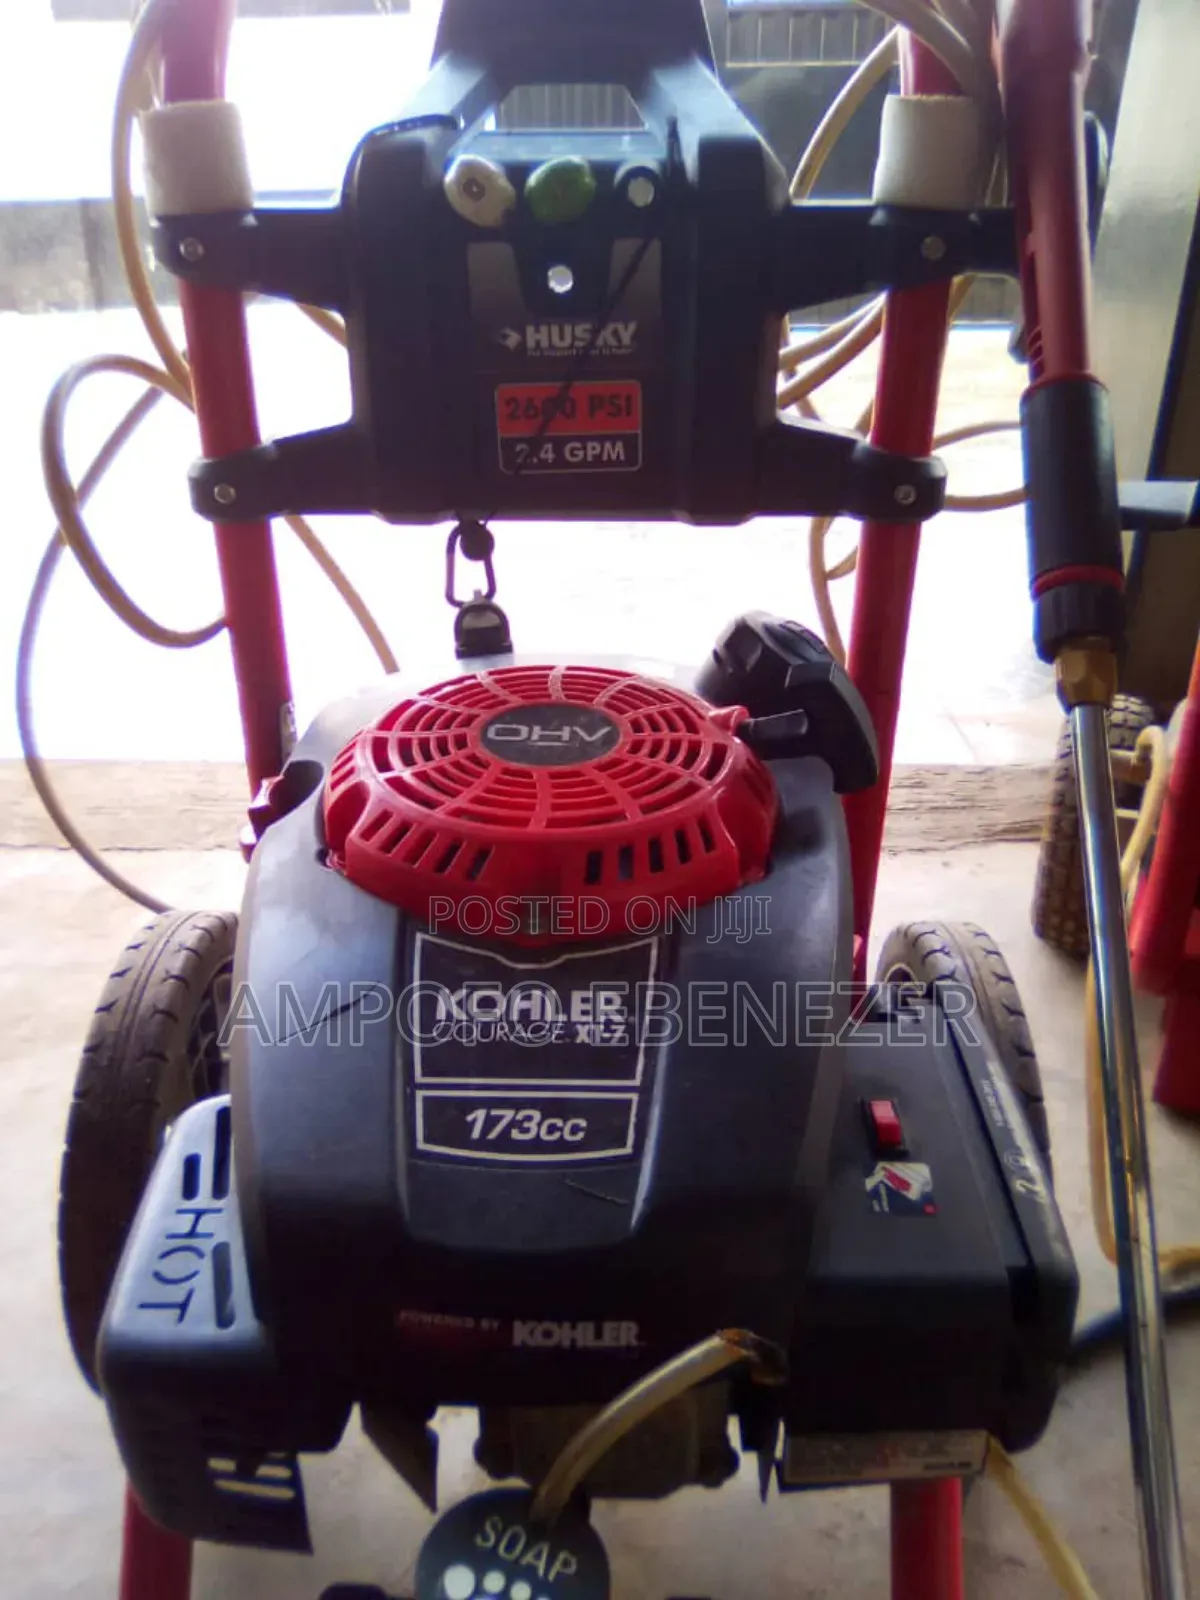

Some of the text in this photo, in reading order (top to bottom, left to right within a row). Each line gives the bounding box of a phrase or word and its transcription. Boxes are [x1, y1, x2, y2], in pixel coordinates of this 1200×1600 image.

[526, 322, 637, 349] HUSKY
[588, 393, 632, 419] PSI
[515, 441, 625, 463] 2.4 GPM
[487, 723, 612, 742] OHV
[436, 989, 625, 1021] KOHLER
[433, 1021, 566, 1044] COURAGE
[465, 1108, 588, 1141] 173cc
[512, 1320, 640, 1348] KOHLER
[474, 1515, 577, 1582] SOAP
